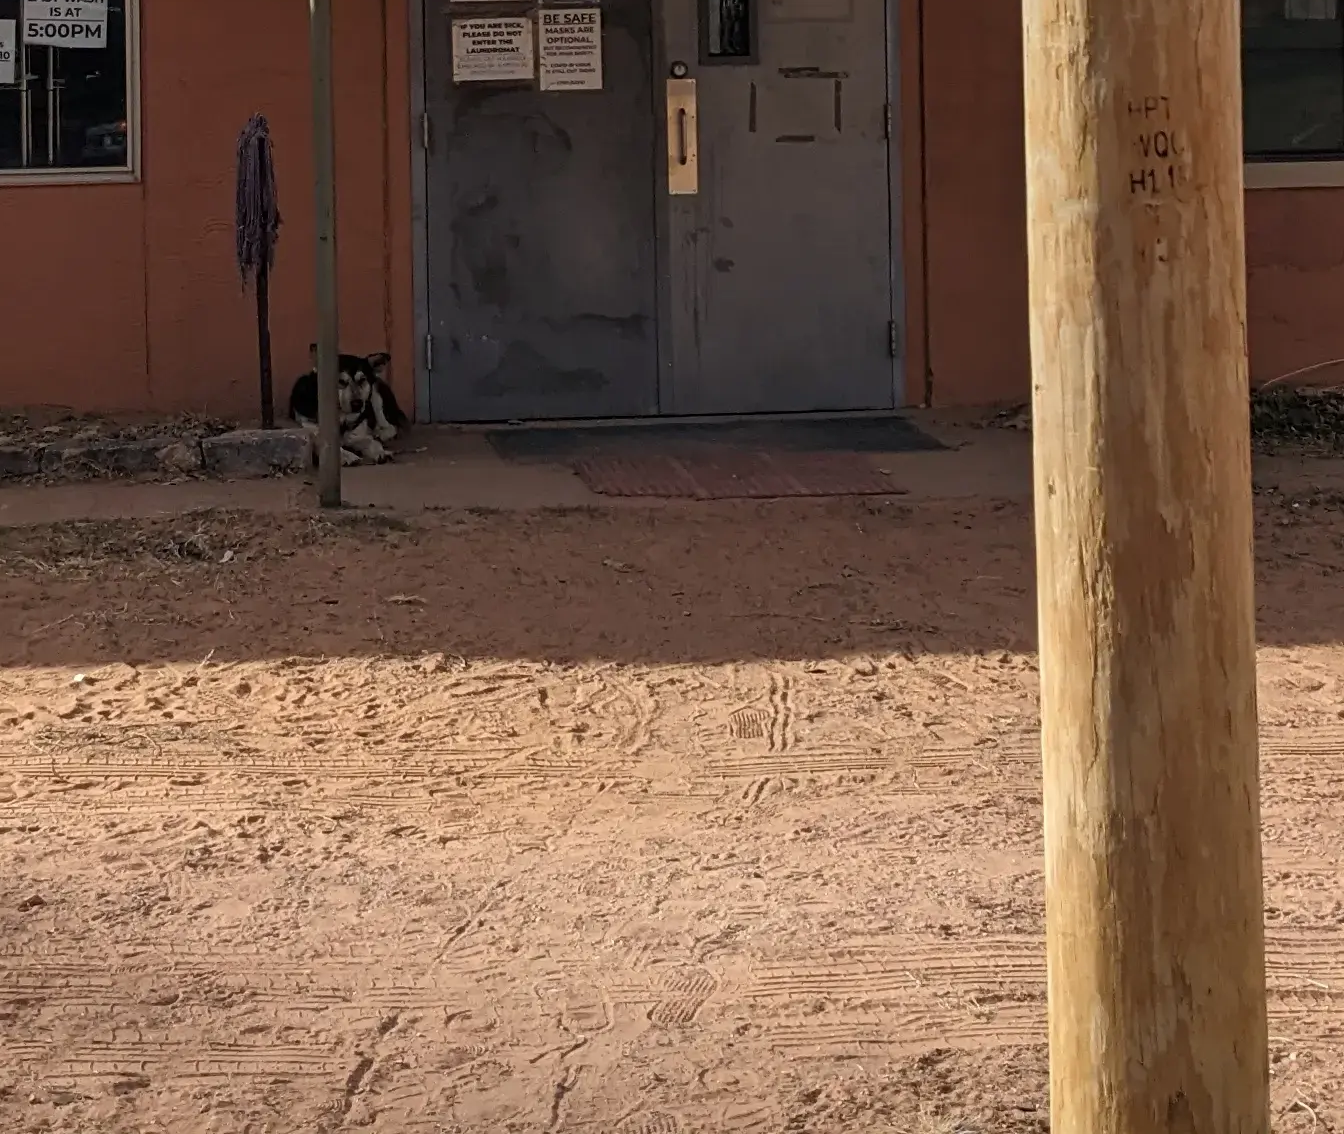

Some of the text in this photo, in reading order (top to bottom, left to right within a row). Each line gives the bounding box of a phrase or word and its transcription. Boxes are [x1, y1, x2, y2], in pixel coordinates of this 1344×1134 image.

[49, 7, 82, 18] IS AT
[543, 13, 597, 24] BE SAFE
[27, 22, 102, 39] 5:00PM
[545, 26, 594, 34] MASKS ARE
